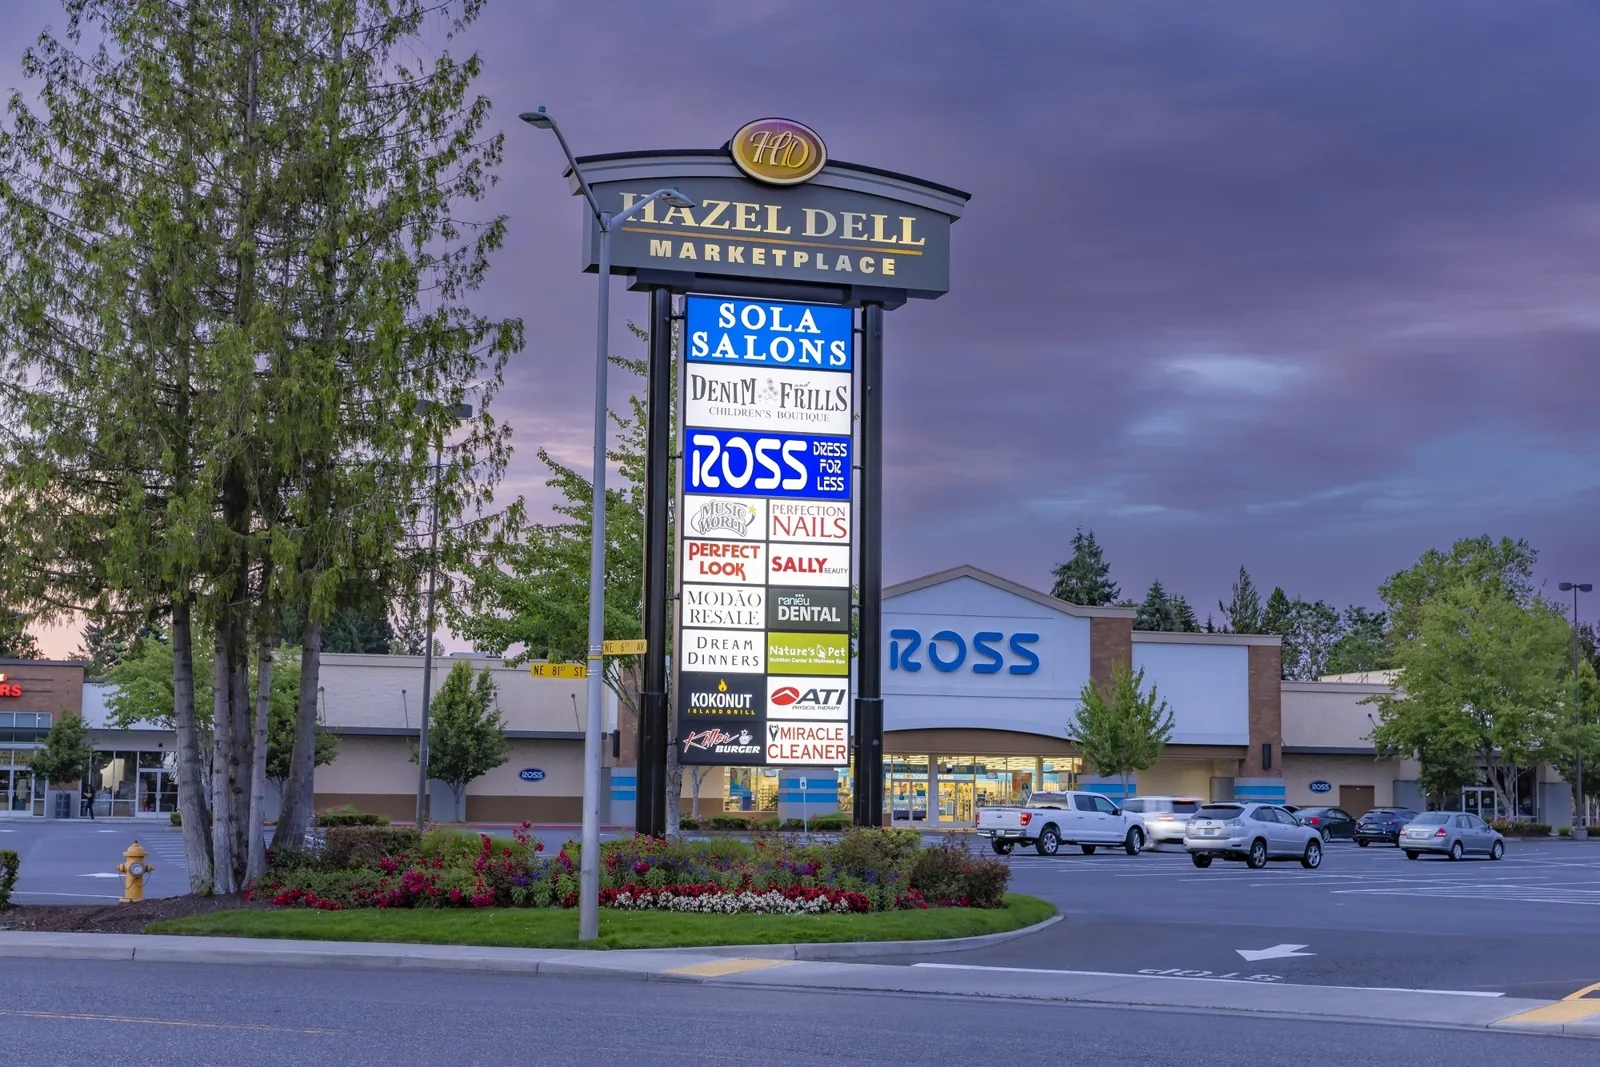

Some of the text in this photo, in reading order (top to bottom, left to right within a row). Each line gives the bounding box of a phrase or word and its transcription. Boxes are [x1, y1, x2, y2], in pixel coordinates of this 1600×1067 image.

[619, 192, 925, 246] HAZEL DELL
[650, 239, 895, 276] MARKETPLACE
[718, 303, 821, 334] SOLA
[692, 331, 847, 366] SALONS
[691, 374, 757, 406] DENIM
[779, 382, 848, 412] FRILLS
[709, 407, 830, 422] CHILDREN'S BOUTIQUE
[813, 441, 848, 457] DRESS
[692, 434, 808, 490] ROSS
[819, 459, 842, 473] FOR
[817, 476, 845, 491] LESS
[701, 500, 747, 522] MUSIC
[772, 504, 846, 517] PERFECTION
[698, 514, 747, 537] WORLD
[773, 515, 847, 538] NAILS
[688, 542, 761, 560] PERFECT
[699, 561, 746, 581] LOOK
[772, 556, 828, 573] SALLY
[689, 609, 760, 625] RESALE
[778, 605, 841, 622] DENTAL
[604, 644, 613, 653] NE
[636, 641, 645, 652] AV
[697, 636, 753, 651] DREAM
[769, 645, 846, 657] Nature's Pet
[688, 651, 760, 667] DINNERS
[890, 629, 1040, 675] ROSS
[533, 665, 544, 676] NE
[574, 667, 583, 677] ST
[691, 692, 752, 708] KOKONUT
[795, 688, 847, 705] ATI
[683, 729, 740, 753] Killer
[780, 727, 844, 740] MIRACLE
[715, 745, 761, 753] BURGER
[768, 743, 846, 759] CLEANER
[521, 771, 544, 779] ROSS
[1311, 783, 1330, 791] ROSS
